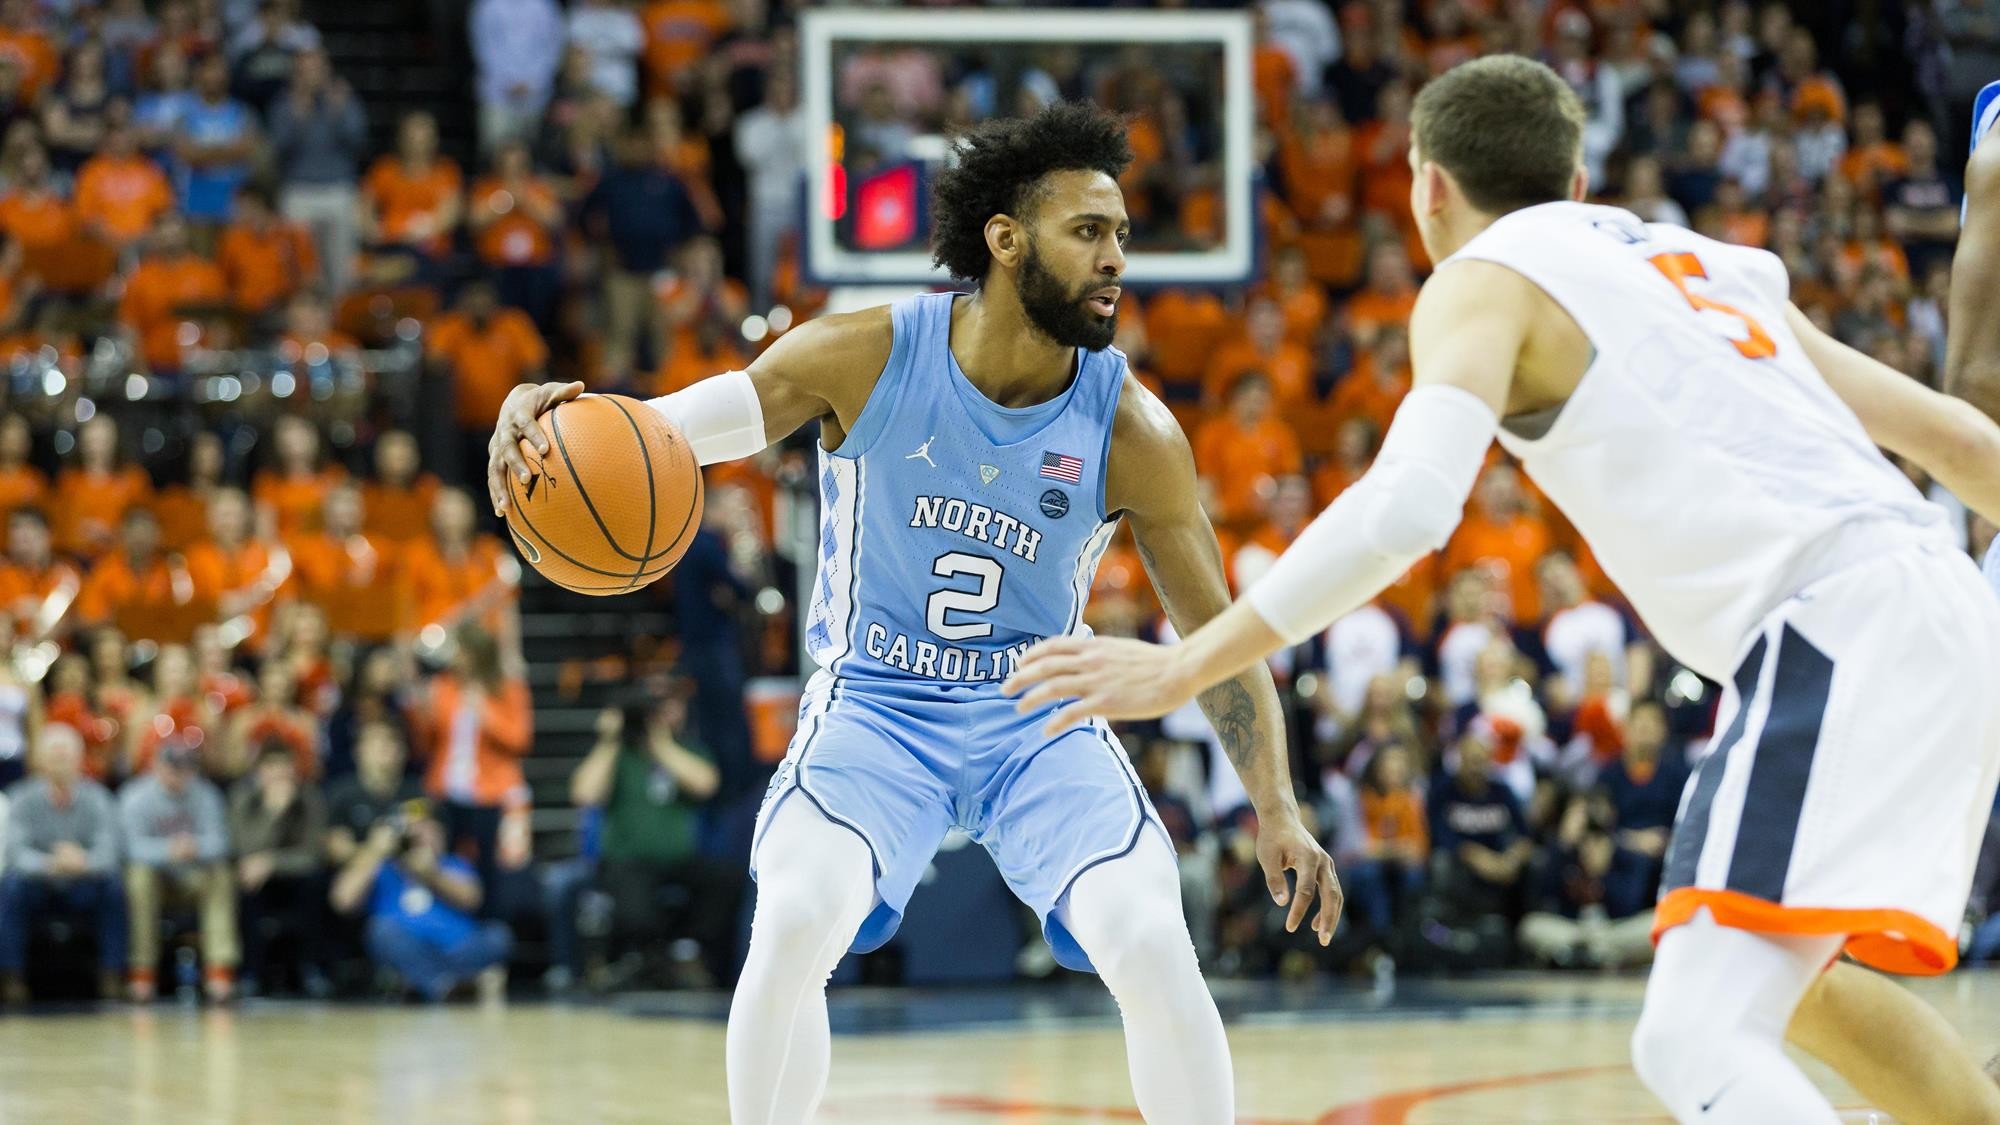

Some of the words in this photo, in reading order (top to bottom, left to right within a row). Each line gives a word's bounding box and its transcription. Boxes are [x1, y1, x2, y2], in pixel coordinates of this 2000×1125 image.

[1646, 251, 1777, 360] 5
[909, 496, 1042, 563] NORTH
[925, 551, 1005, 641] 2
[865, 622, 1043, 682] CAROLIN
